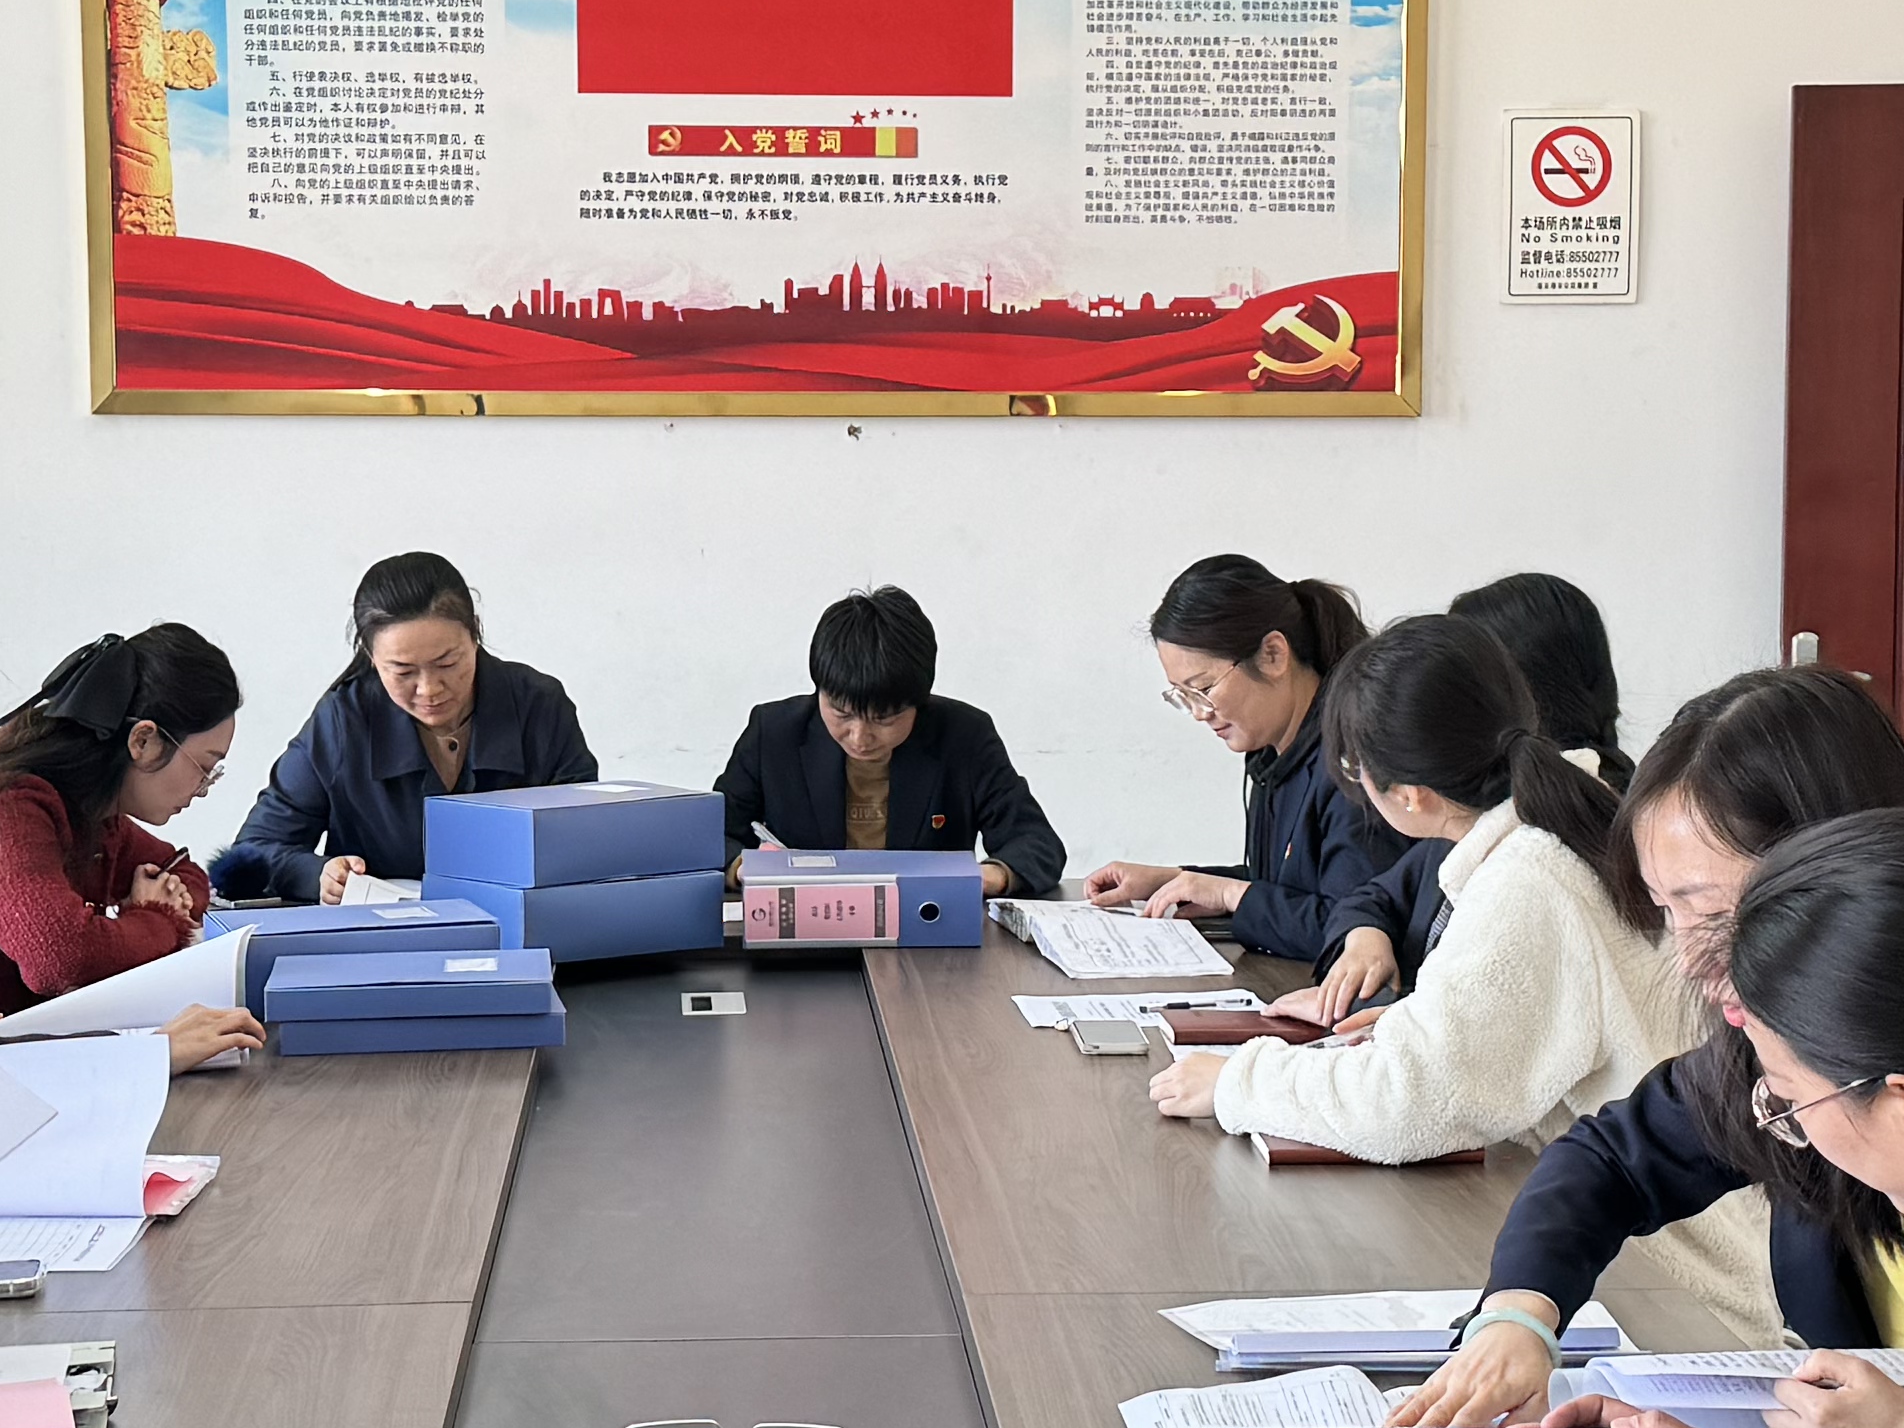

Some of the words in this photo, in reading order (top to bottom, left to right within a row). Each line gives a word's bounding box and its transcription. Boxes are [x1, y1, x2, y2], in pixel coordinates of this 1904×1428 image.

[719, 128, 842, 154] 入党誓词
[1521, 216, 1621, 231] 本场所内禁止吸烟
[1521, 233, 1541, 243] No
[1550, 233, 1620, 244] Smoking
[1520, 250, 1620, 265] 监督电话:85502777
[1520, 268, 1619, 279] Hotline:85502777
